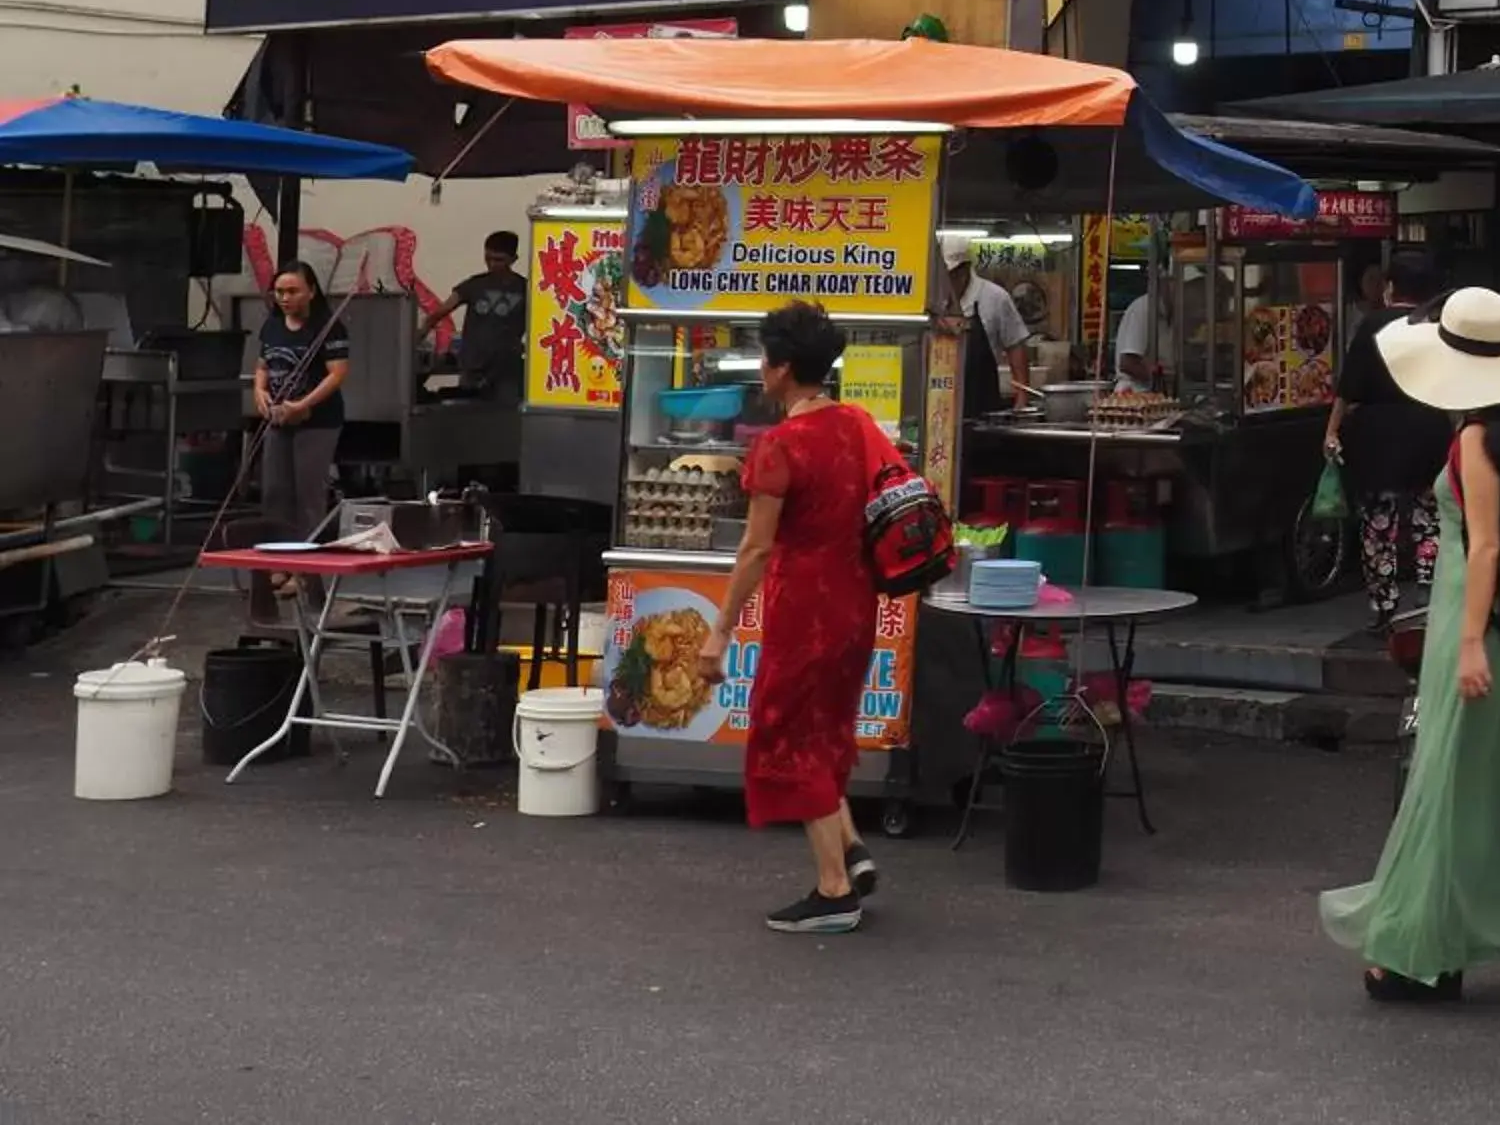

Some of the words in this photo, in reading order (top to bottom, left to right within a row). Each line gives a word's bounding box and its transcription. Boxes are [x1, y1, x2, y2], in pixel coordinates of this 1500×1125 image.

[745, 194, 891, 233] 美味天王
[732, 242, 835, 265] Delicious
[843, 243, 896, 270] King
[671, 270, 713, 293] LONG
[717, 271, 759, 294] CHYE
[766, 273, 810, 294] CHAR
[816, 274, 859, 295] KOAY
[865, 275, 913, 296] TEOW
